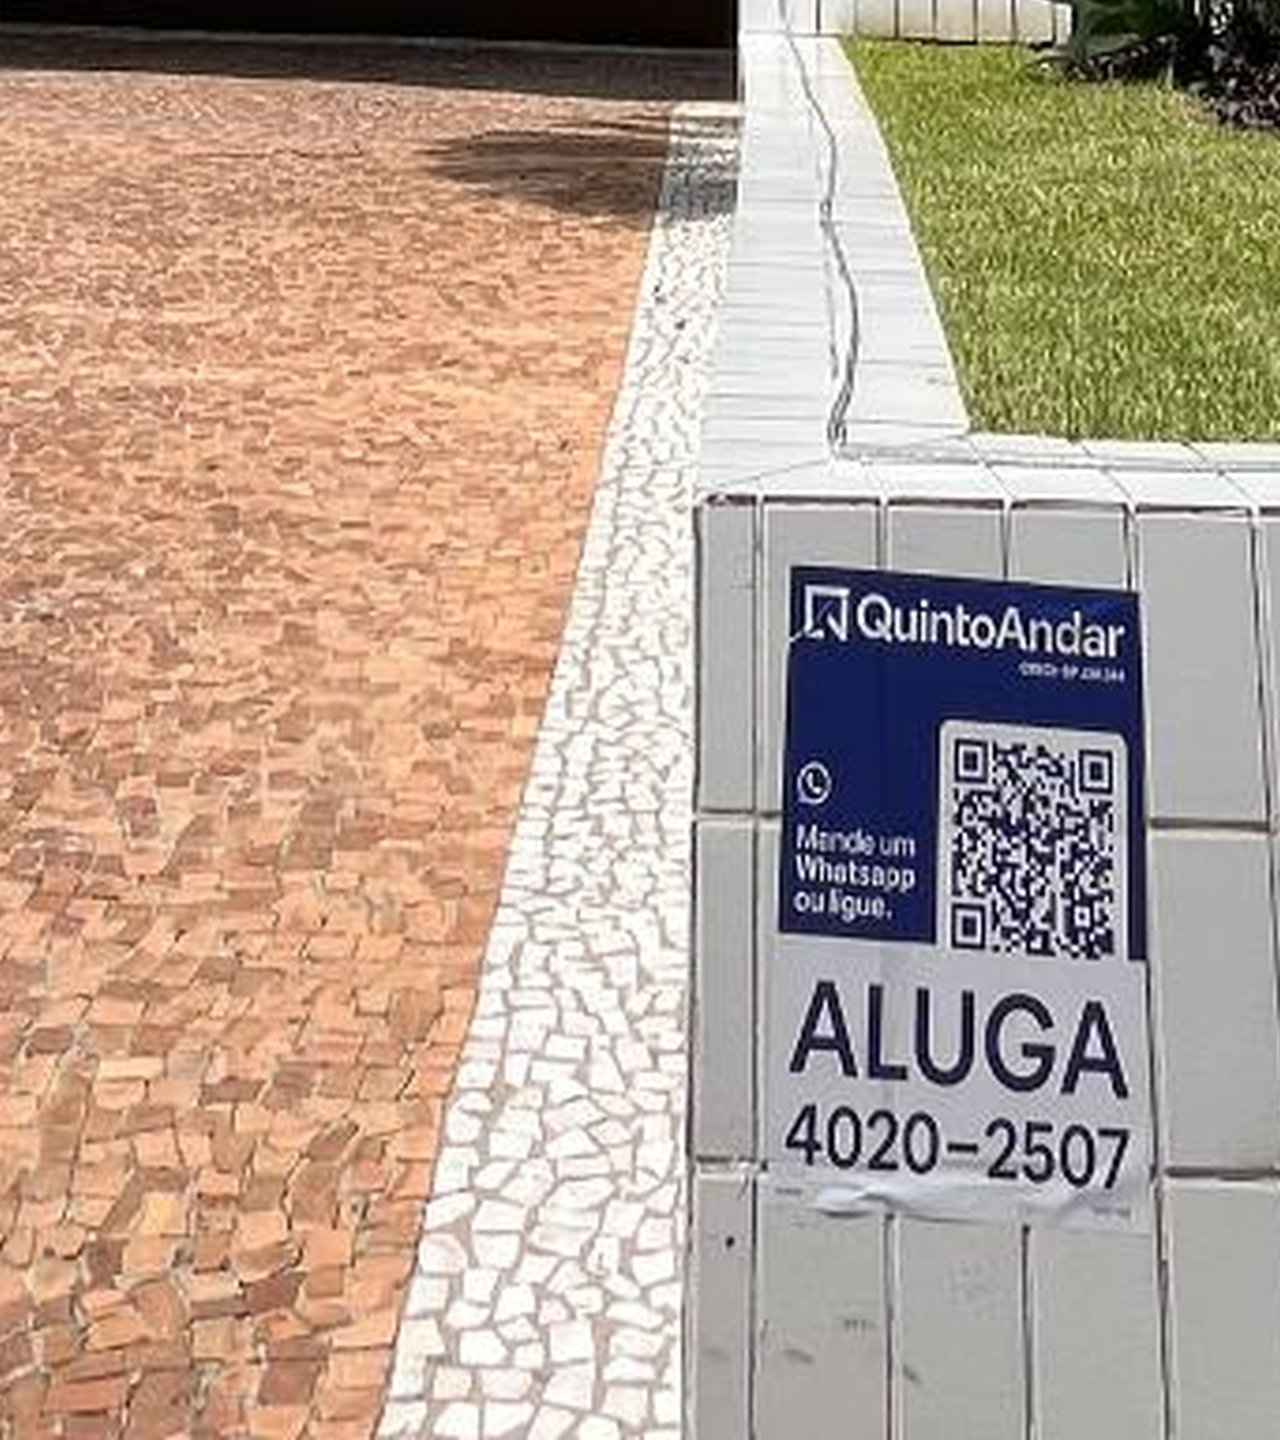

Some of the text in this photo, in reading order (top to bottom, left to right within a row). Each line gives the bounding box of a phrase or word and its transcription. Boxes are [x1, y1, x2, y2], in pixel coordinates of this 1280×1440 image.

[856, 593, 1125, 659] QuintoAndar
[796, 824, 917, 858] Mande um
[794, 891, 825, 913] ou
[788, 979, 1129, 1100] ALUGA
[784, 1103, 1130, 1190] 4020-2507
